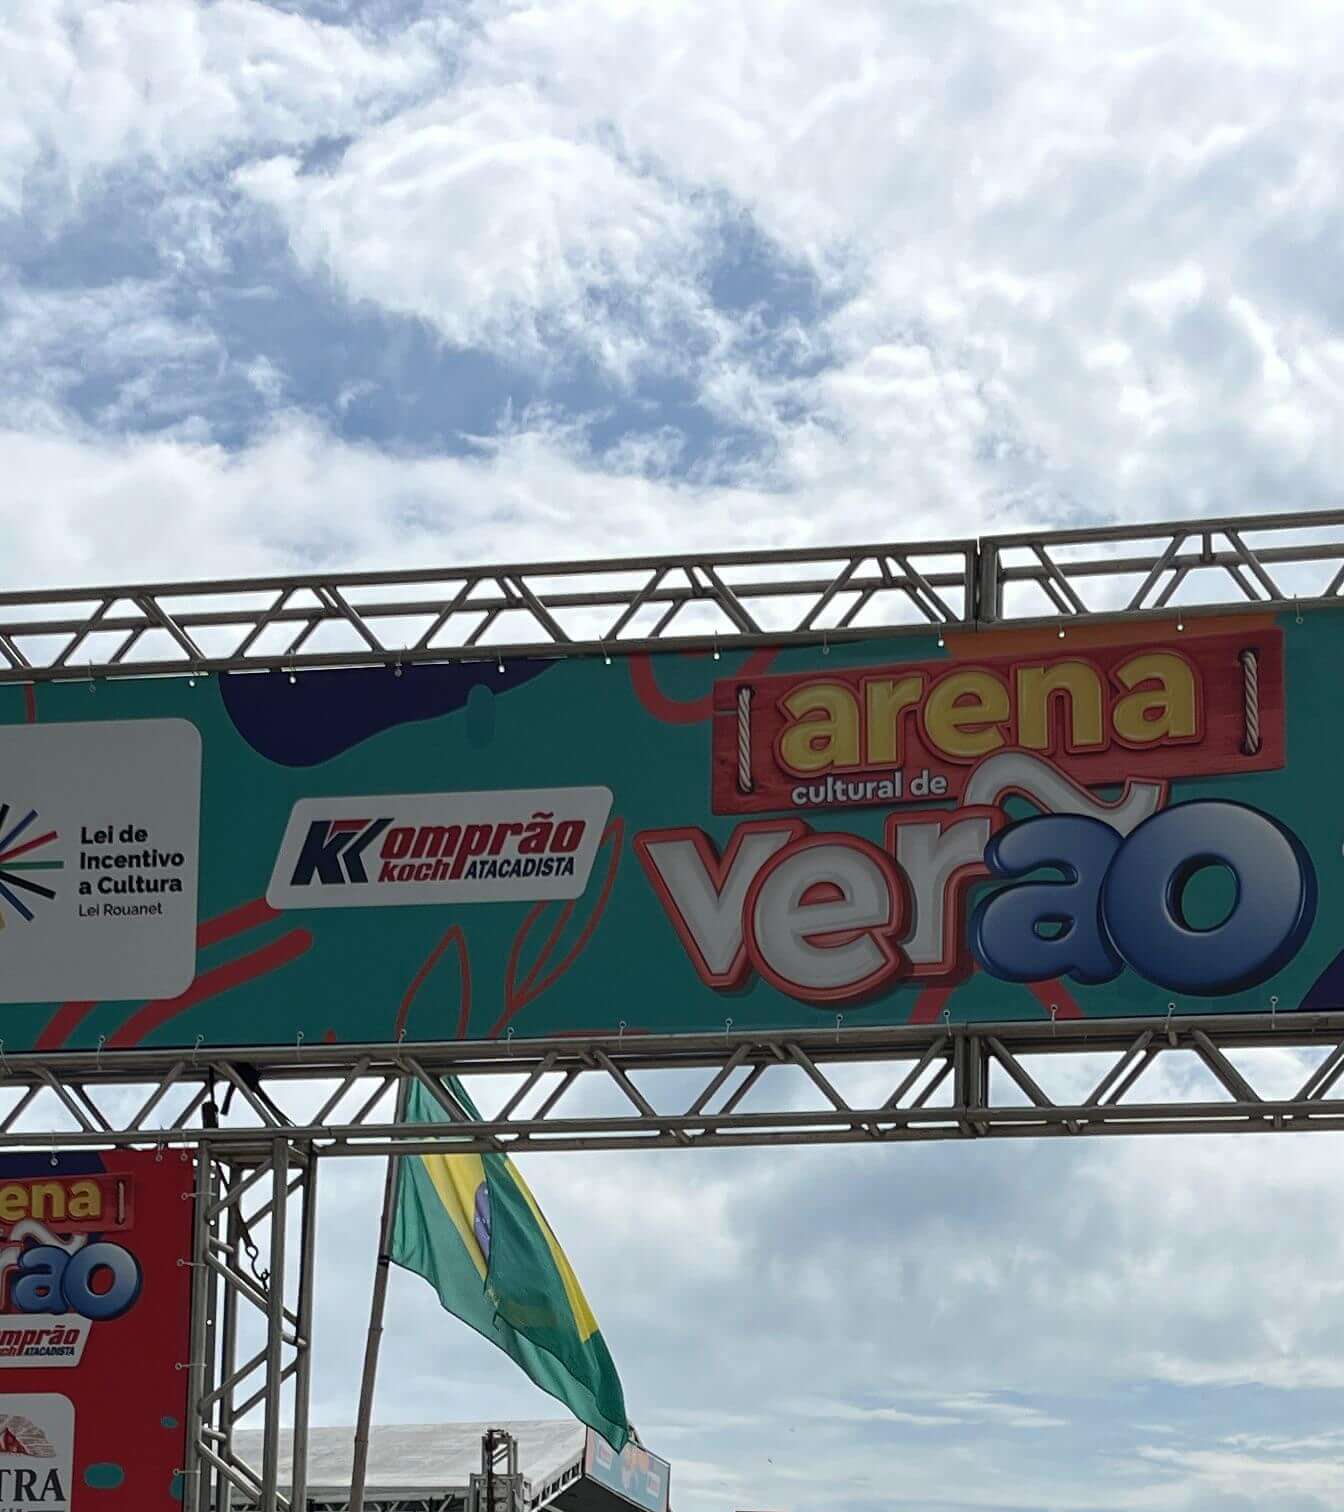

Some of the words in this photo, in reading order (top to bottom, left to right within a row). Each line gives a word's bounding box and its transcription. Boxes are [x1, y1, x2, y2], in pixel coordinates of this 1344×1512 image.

[775, 648, 1202, 775] arena
[790, 772, 903, 805] cultural
[909, 770, 948, 797] de
[81, 825, 114, 844] Lei
[119, 824, 148, 843] de
[80, 849, 185, 869] Incentivo
[464, 856, 575, 880] ATACADISTA
[78, 881, 92, 895] a
[97, 875, 183, 894] Cultura
[636, 748, 1317, 1003] verão
[79, 904, 99, 917] Lei
[104, 902, 163, 916] Rouanet
[24, 1347, 75, 1357] ATACADISTA
